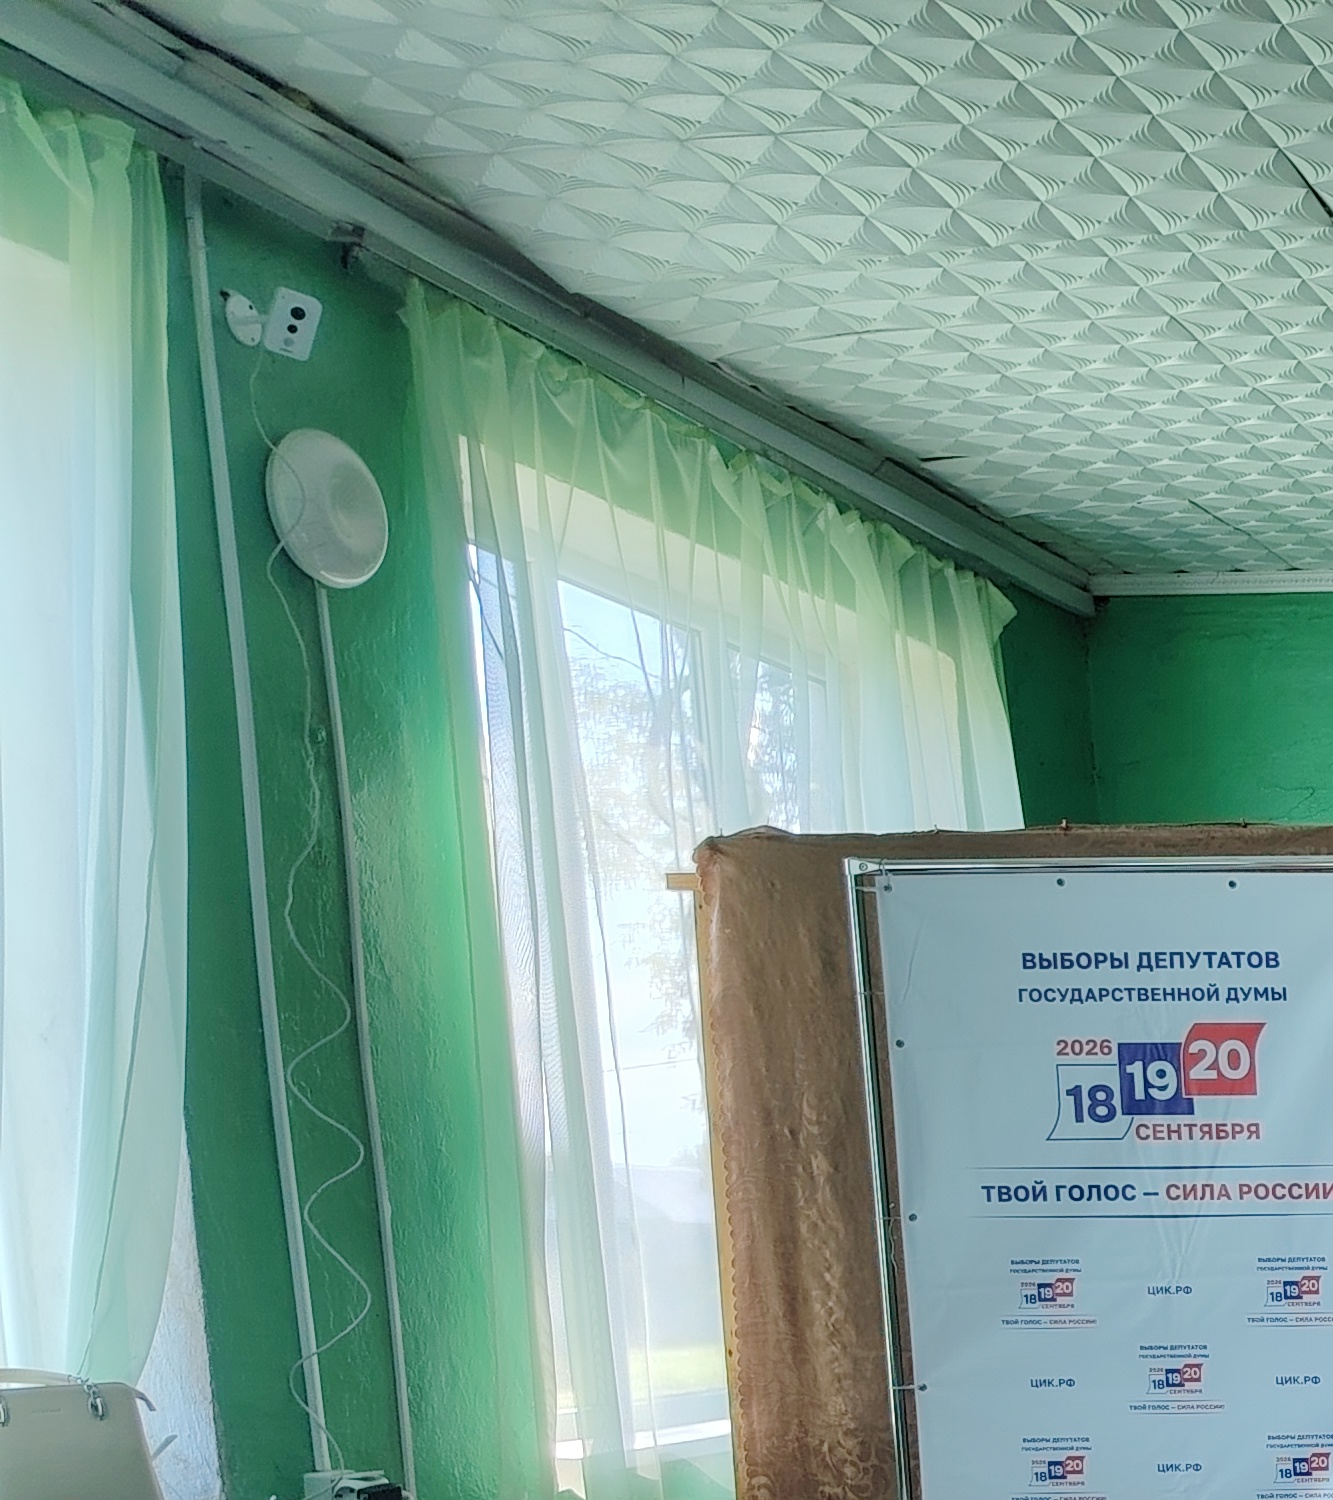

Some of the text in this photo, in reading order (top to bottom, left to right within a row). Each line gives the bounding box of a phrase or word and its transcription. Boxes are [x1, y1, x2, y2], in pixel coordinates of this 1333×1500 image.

[1021, 951, 1281, 973] ВЫБОРЫ ДЕПУТАТОВ
[1017, 983, 1288, 1004] ГОСУДАРСТВЕННОЙ ДУМЫ
[1055, 1039, 1114, 1057] 2026
[1065, 1039, 1251, 1124] 18 19 20
[1134, 1123, 1261, 1141] СЕНТЯБРЯ
[980, 1179, 1048, 1203] ТВОЙ
[1054, 1184, 1137, 1202] ГОЛОС
[1165, 1183, 1231, 1202] СИЛА
[1024, 1282, 1071, 1304] 18 19 20
[1147, 1284, 1193, 1298] ЦИК.РФ
[1270, 1280, 1318, 1302] 18 19 20
[1030, 1377, 1076, 1390] ЦИК.РФ
[1152, 1368, 1199, 1389] 18 19 20
[1275, 1374, 1321, 1387] ЦИК.РФ
[1034, 1460, 1082, 1482] 18 19 20
[1157, 1461, 1202, 1475] ЦИК.РФ
[1279, 1457, 1328, 1478] 18 19 20
